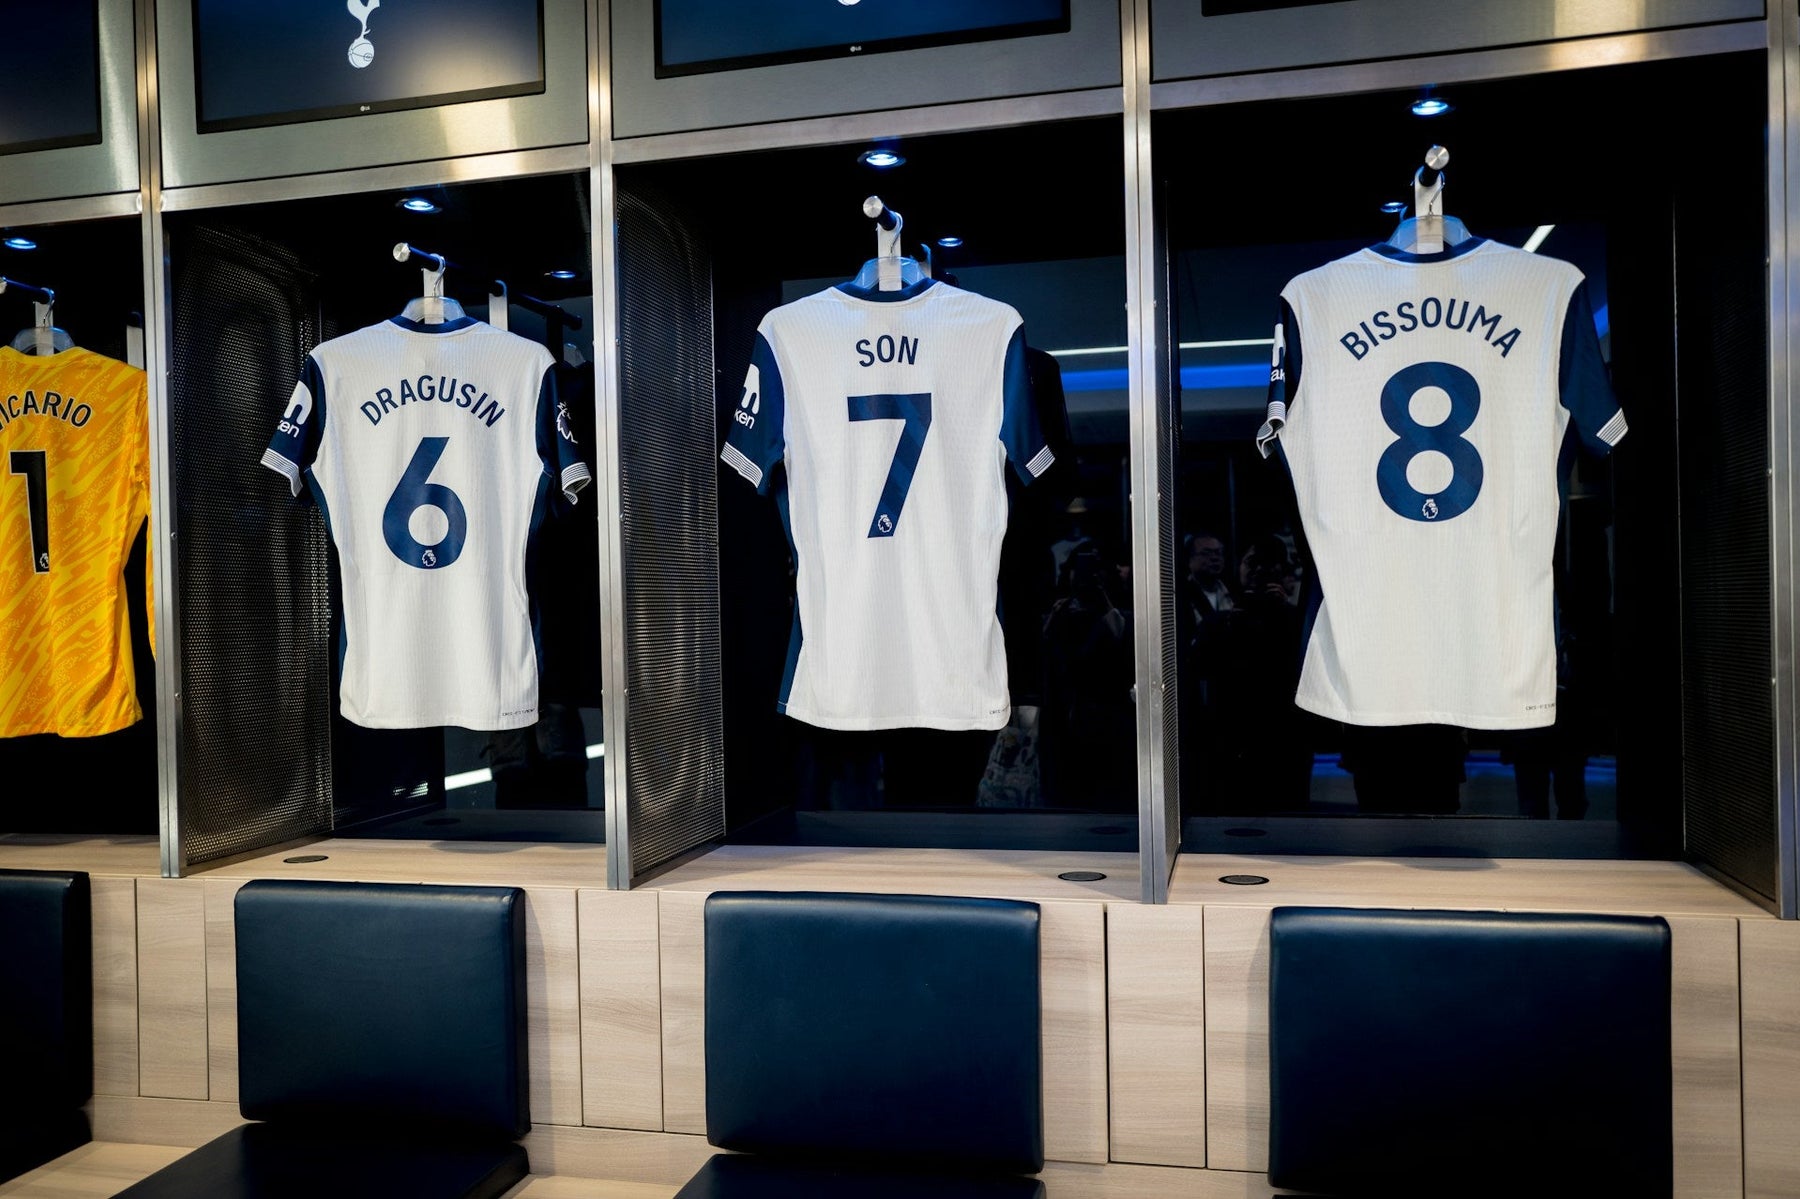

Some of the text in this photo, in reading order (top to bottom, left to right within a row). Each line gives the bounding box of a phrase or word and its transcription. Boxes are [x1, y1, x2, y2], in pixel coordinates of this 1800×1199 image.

[856, 335, 918, 367] SON
[1340, 297, 1521, 360] BISSOUMA
[0, 390, 92, 429] ICARIO
[278, 420, 300, 438] en
[361, 375, 505, 427] DRAGUSIN
[847, 393, 932, 538] 7
[1377, 362, 1483, 522] 8
[10, 450, 49, 573] 1
[383, 437, 467, 569] 6
